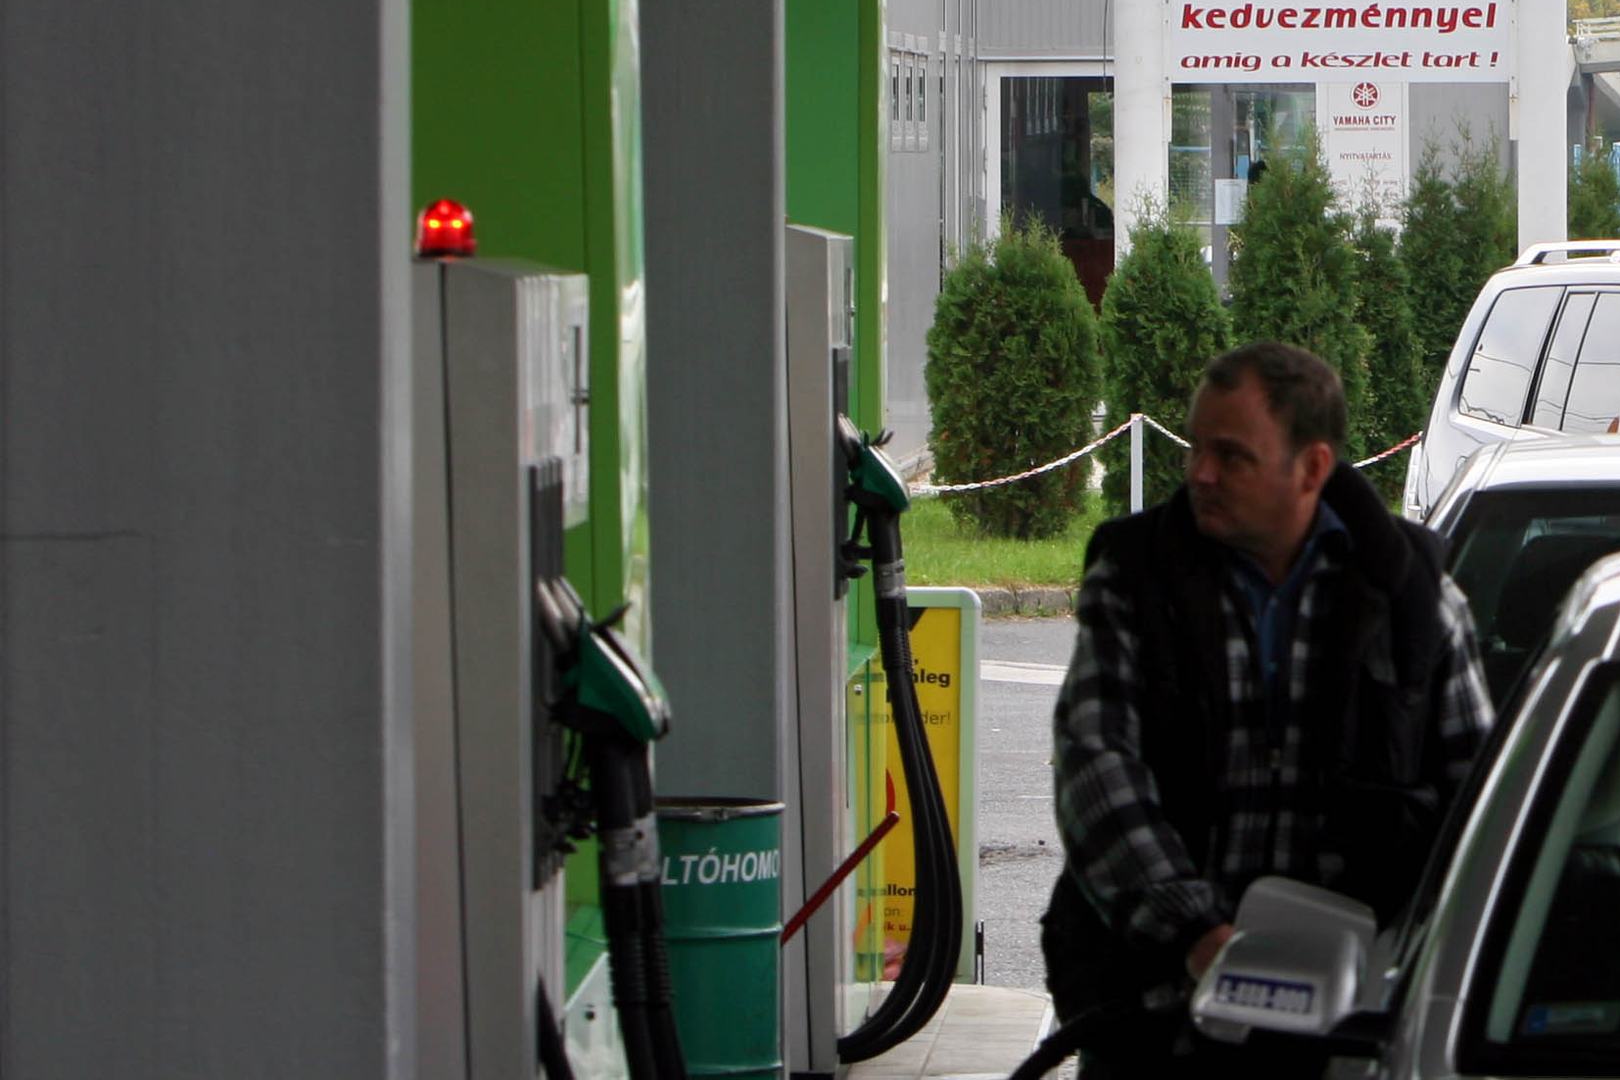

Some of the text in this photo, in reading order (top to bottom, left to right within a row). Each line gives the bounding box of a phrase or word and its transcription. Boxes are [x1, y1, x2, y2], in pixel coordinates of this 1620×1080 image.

[1182, 3, 1497, 33] kedvezménnyel
[1272, 56, 1291, 68] a
[1301, 52, 1413, 68] készlet
[1422, 52, 1479, 68] tart
[1333, 115, 1397, 126] YAMAHA CITY
